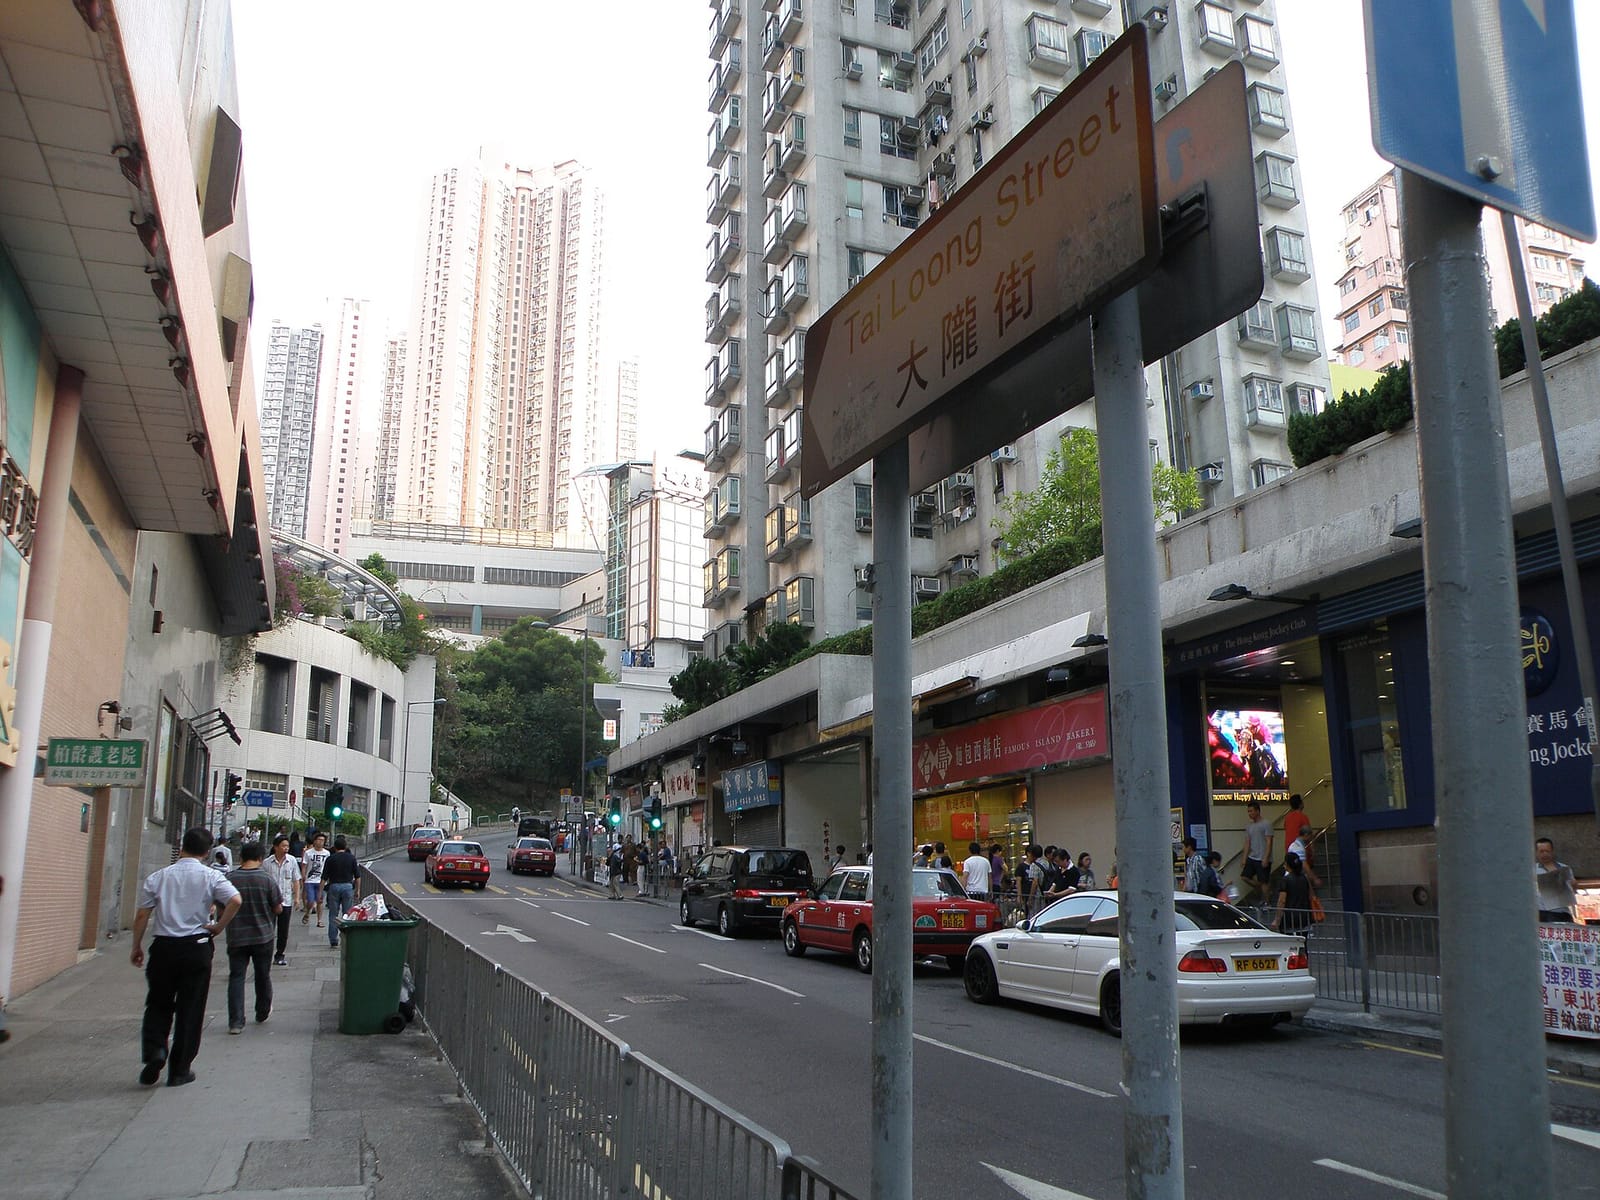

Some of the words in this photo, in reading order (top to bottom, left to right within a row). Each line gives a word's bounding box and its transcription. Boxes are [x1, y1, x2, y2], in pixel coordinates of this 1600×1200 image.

[844, 294, 881, 354] Tai
[890, 215, 983, 322] Loong
[996, 84, 1121, 227] Street
[896, 251, 1038, 408] 大隴街
[1004, 741, 1030, 755] FAMOUS
[1035, 735, 1061, 748] ISLAND
[1066, 727, 1095, 741] BAKERY
[1234, 792, 1252, 802] Happy
[1252, 792, 1270, 802] Valley
[1236, 961, 1249, 971] RF
[1251, 959, 1276, 969] 6627
